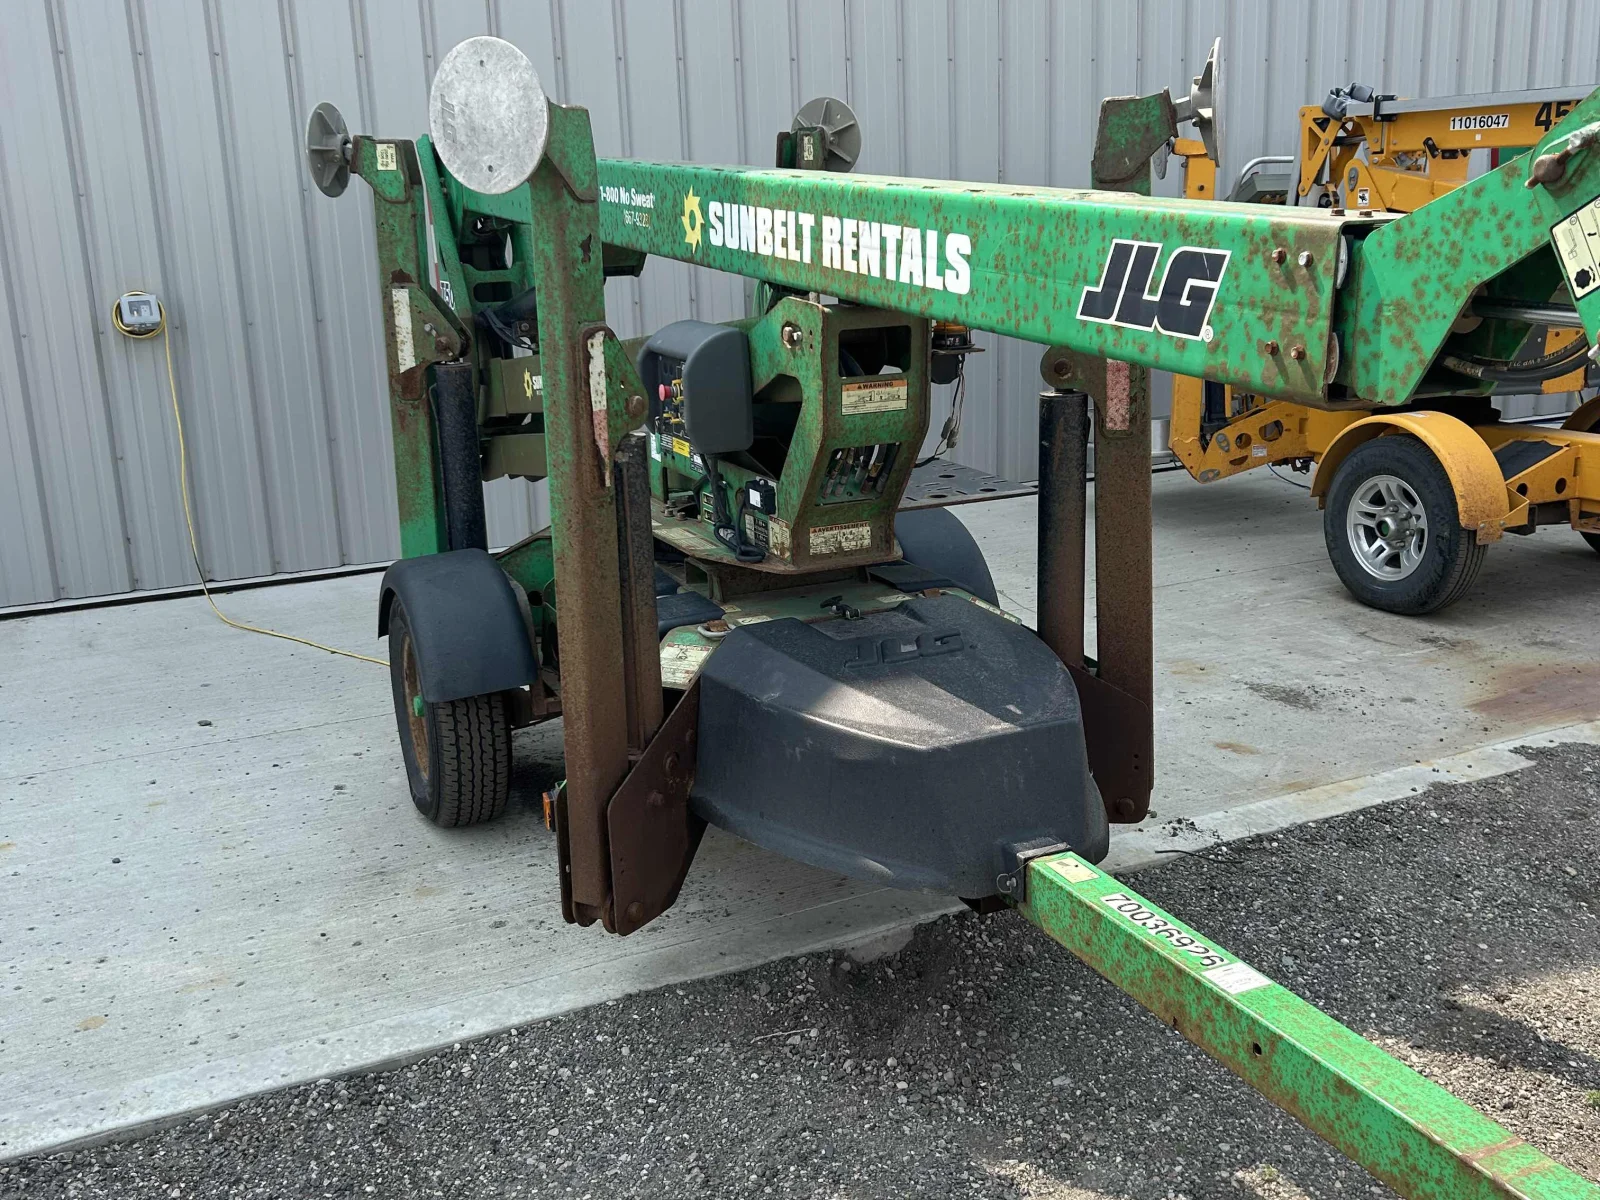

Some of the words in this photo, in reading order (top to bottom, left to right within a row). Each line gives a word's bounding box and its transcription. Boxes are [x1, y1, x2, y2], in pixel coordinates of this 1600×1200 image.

[1450, 114, 1509, 130] 11016047
[599, 185, 619, 203] 1-800
[619, 186, 630, 205] No
[630, 187, 655, 209] Sweat
[708, 200, 815, 264] SUNBELT
[822, 215, 971, 295] RENTALS
[1076, 238, 1232, 342] JLG
[862, 381, 894, 390] WARNING
[843, 631, 964, 668] JLG
[1104, 893, 1225, 967] 70036926
